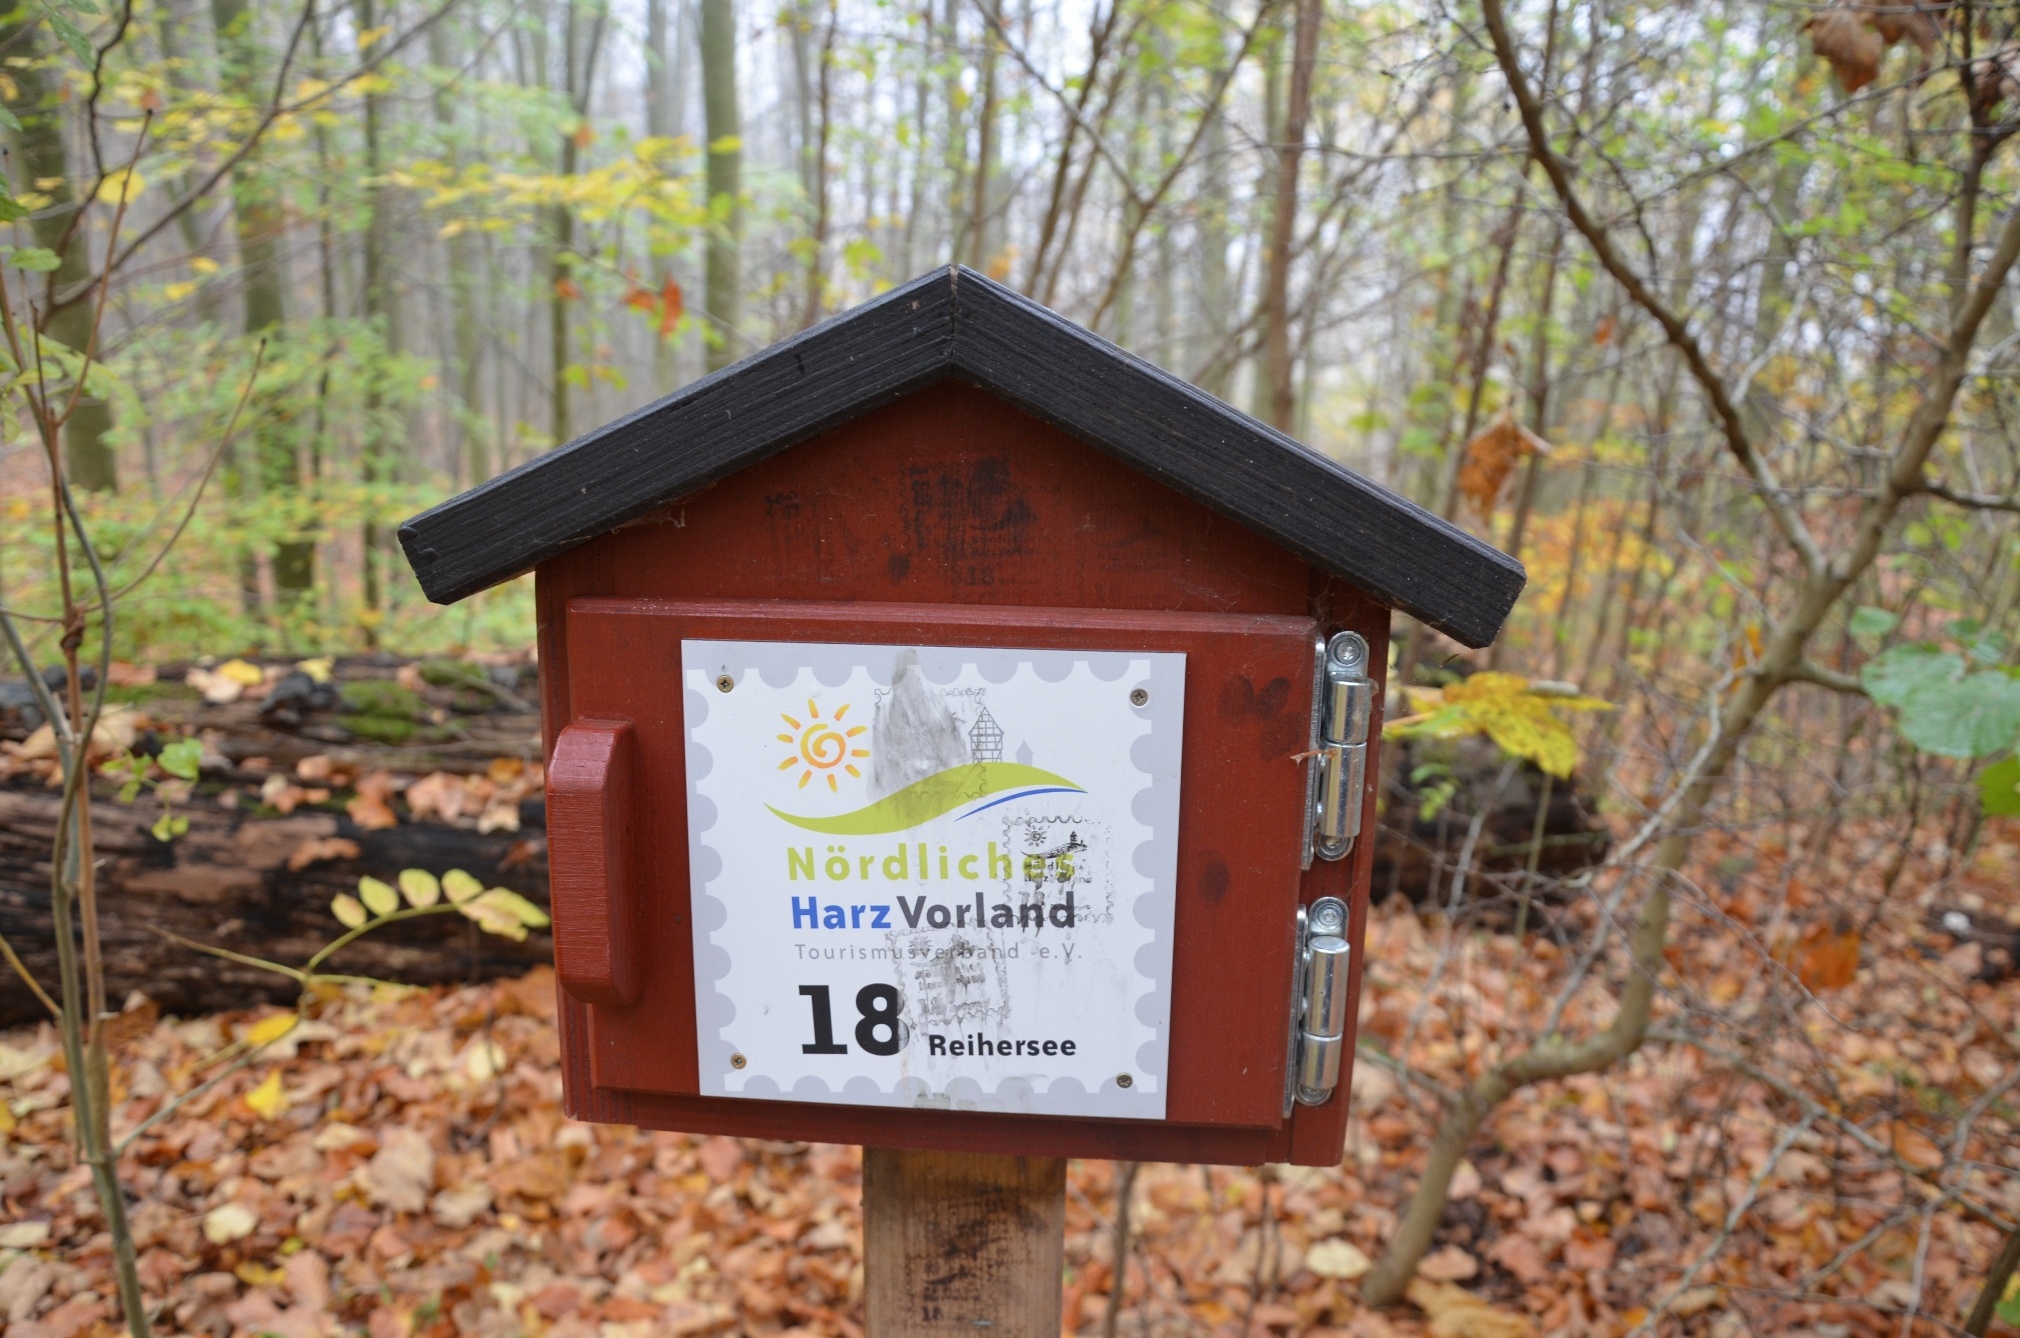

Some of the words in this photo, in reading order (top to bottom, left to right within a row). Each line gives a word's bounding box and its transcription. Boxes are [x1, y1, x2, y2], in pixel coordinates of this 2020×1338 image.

[787, 842, 1075, 881] Nördliches
[791, 892, 1075, 929] HarzVorland
[795, 943, 1020, 960] Tourismusverband
[1040, 943, 1082, 960] e.V.
[798, 983, 910, 1056] 18
[929, 1033, 1077, 1056] Reihersee
